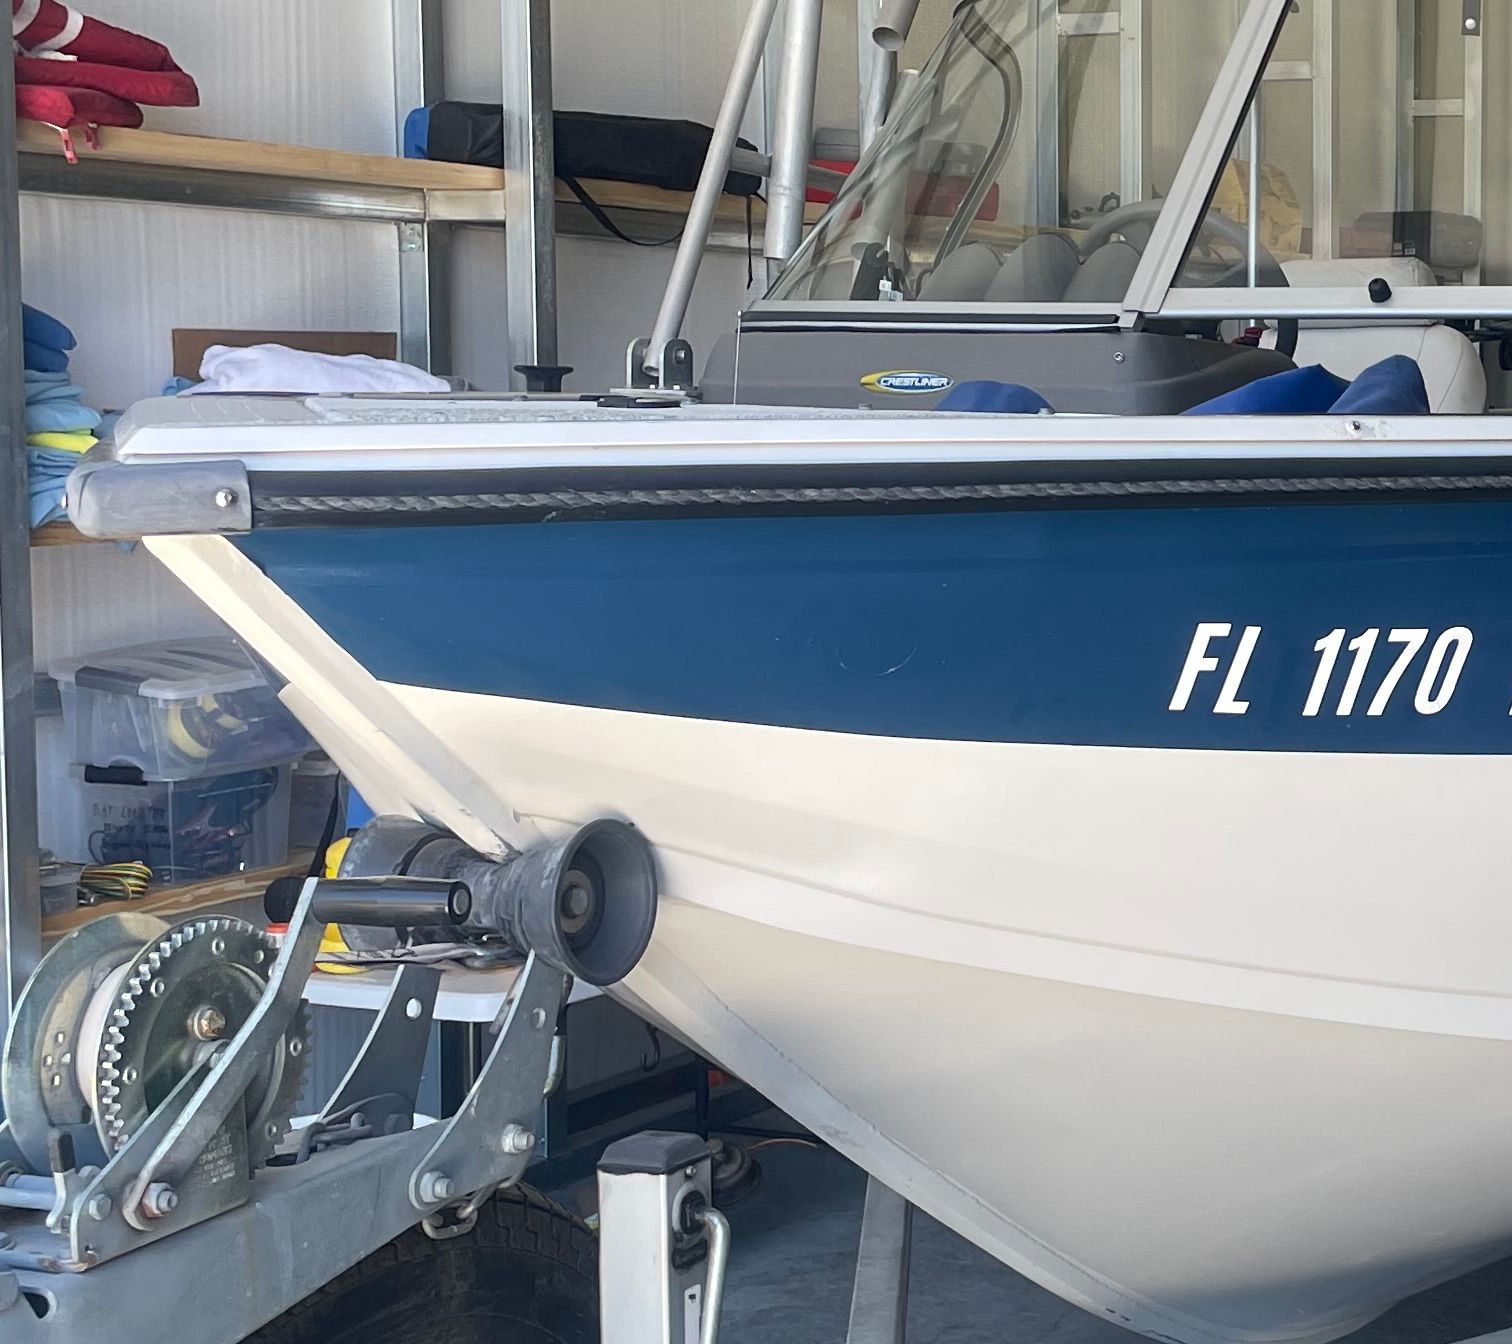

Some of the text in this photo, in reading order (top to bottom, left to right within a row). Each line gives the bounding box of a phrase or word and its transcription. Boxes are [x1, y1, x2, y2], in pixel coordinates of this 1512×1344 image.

[880, 376, 948, 388] CRESTLINER
[1168, 622, 1262, 715] FL
[1301, 626, 1474, 717] 1170
